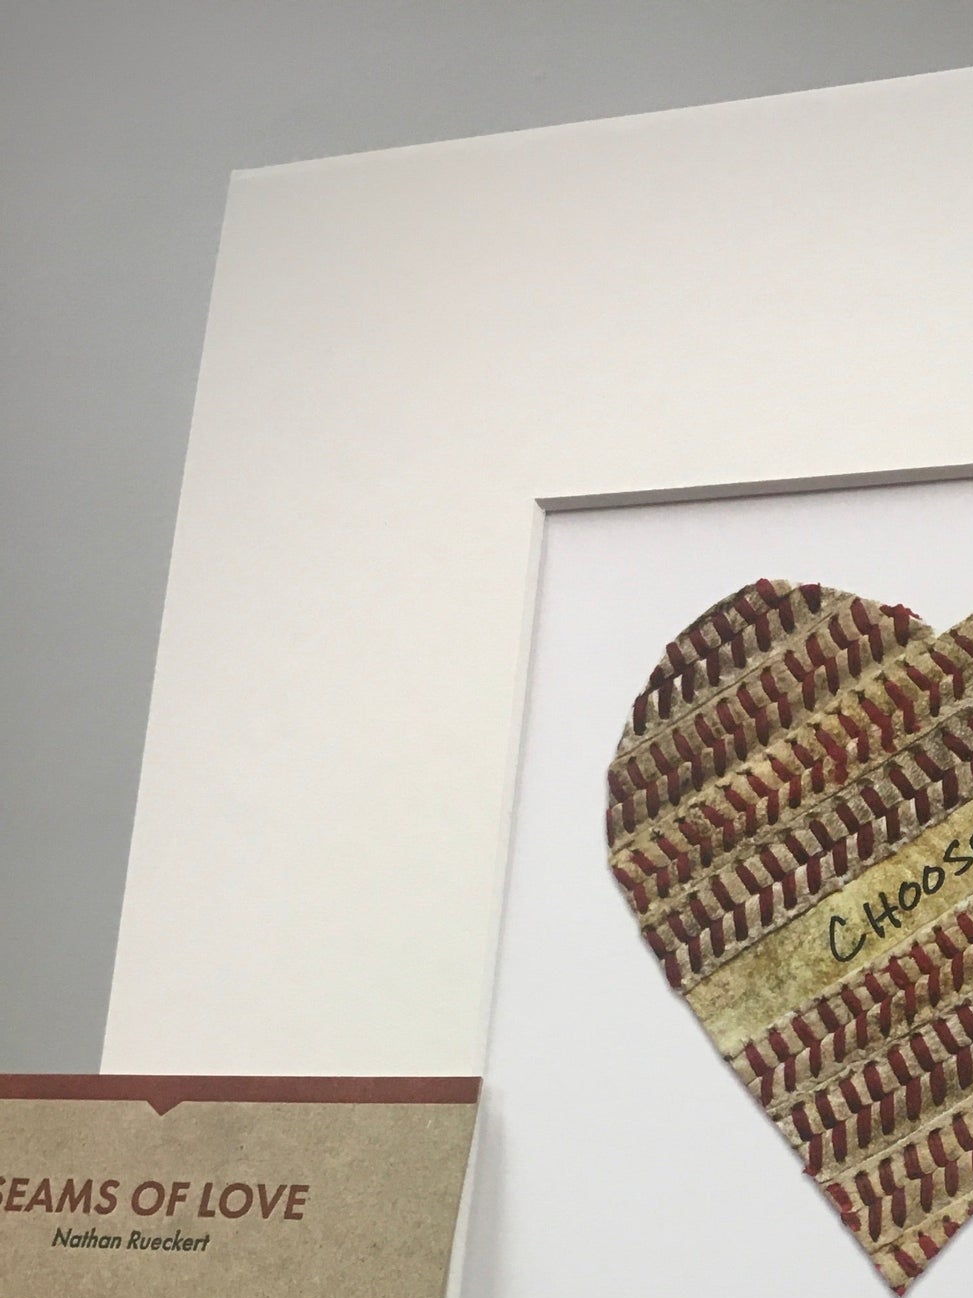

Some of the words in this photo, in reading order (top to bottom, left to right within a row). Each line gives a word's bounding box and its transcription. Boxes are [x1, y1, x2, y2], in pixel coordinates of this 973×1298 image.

[0, 1178, 120, 1215] EAMS
[131, 1180, 191, 1217] OF
[198, 1183, 309, 1220] LOVE
[52, 1228, 122, 1251] Nathan
[127, 1230, 210, 1252] Rueckert
